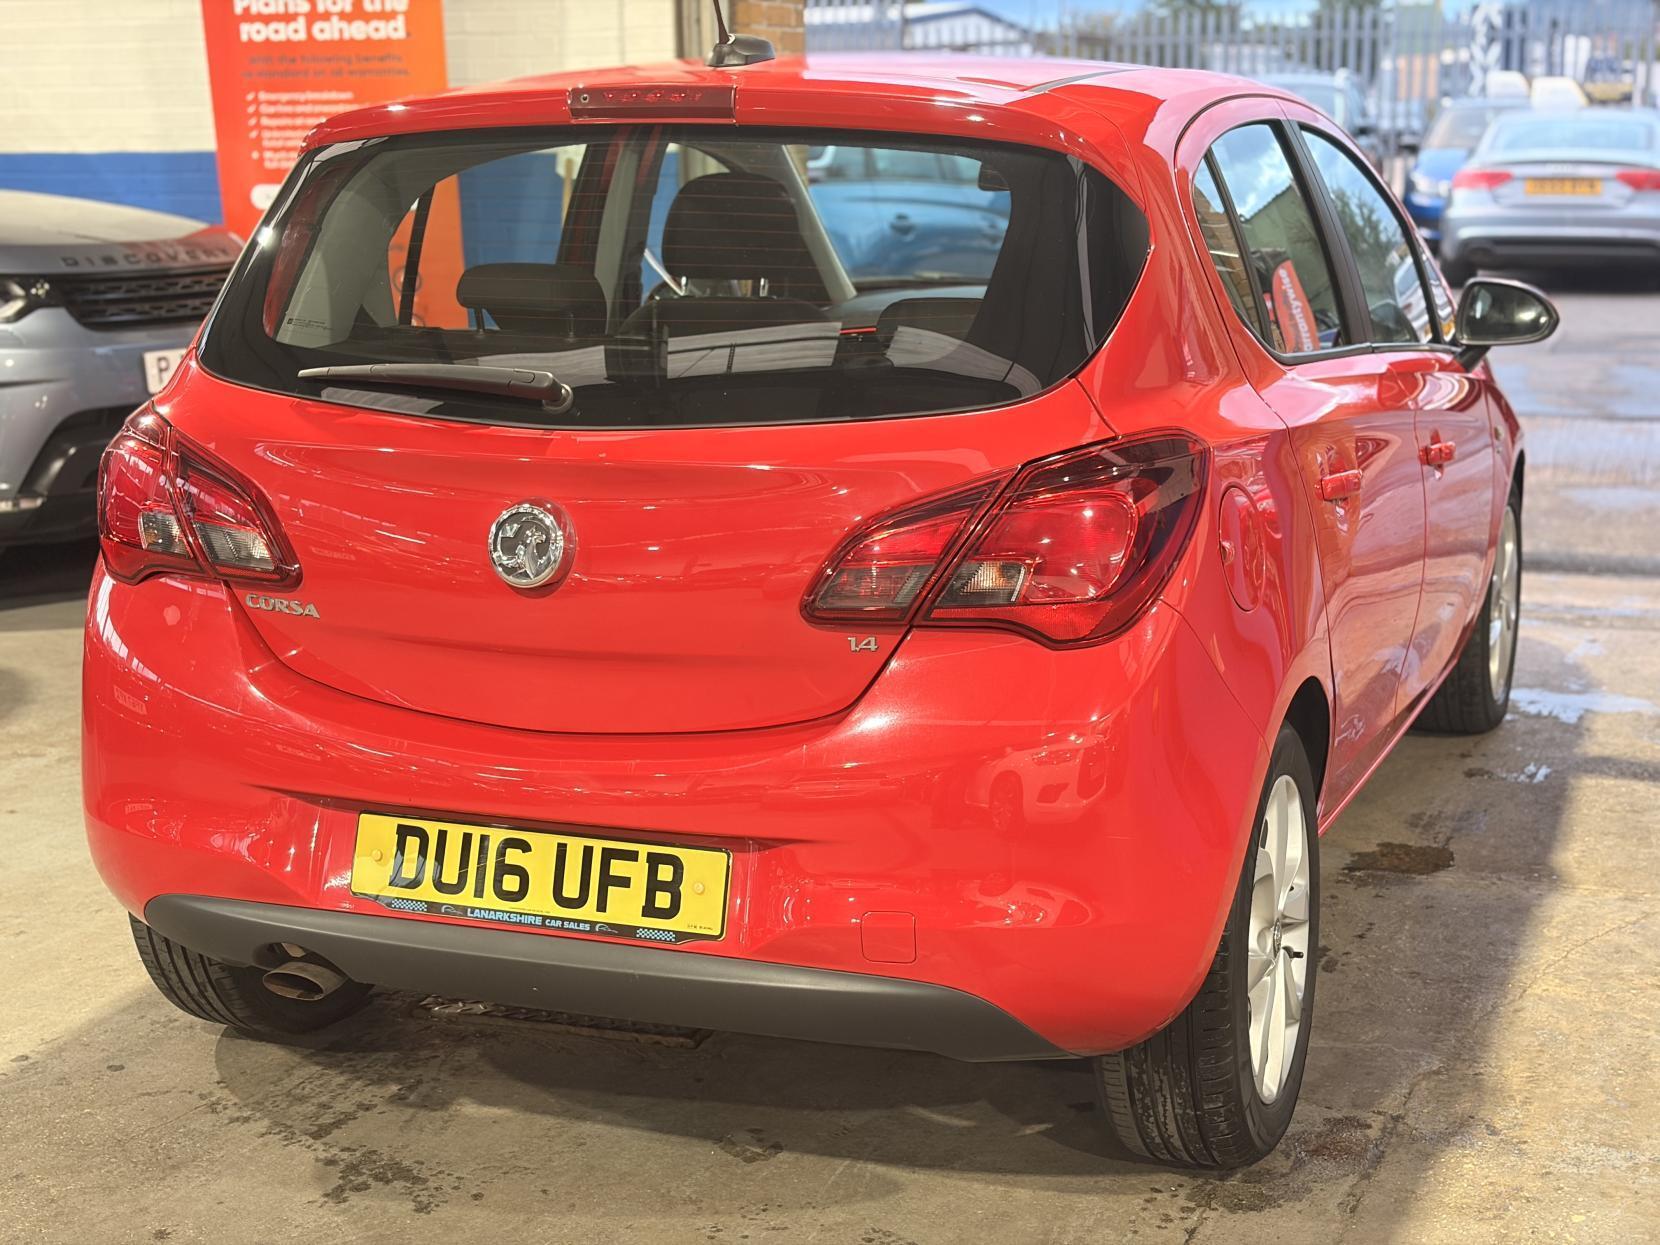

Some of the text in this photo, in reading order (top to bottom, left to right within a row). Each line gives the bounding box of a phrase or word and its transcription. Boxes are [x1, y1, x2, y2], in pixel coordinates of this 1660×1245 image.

[240, 15, 307, 42] road
[245, 593, 321, 619] CORSA
[388, 824, 684, 920] DU16 UFB
[467, 908, 543, 925] LANARKSHIRE
[545, 919, 562, 928] CAR
[563, 921, 591, 931] SALES
